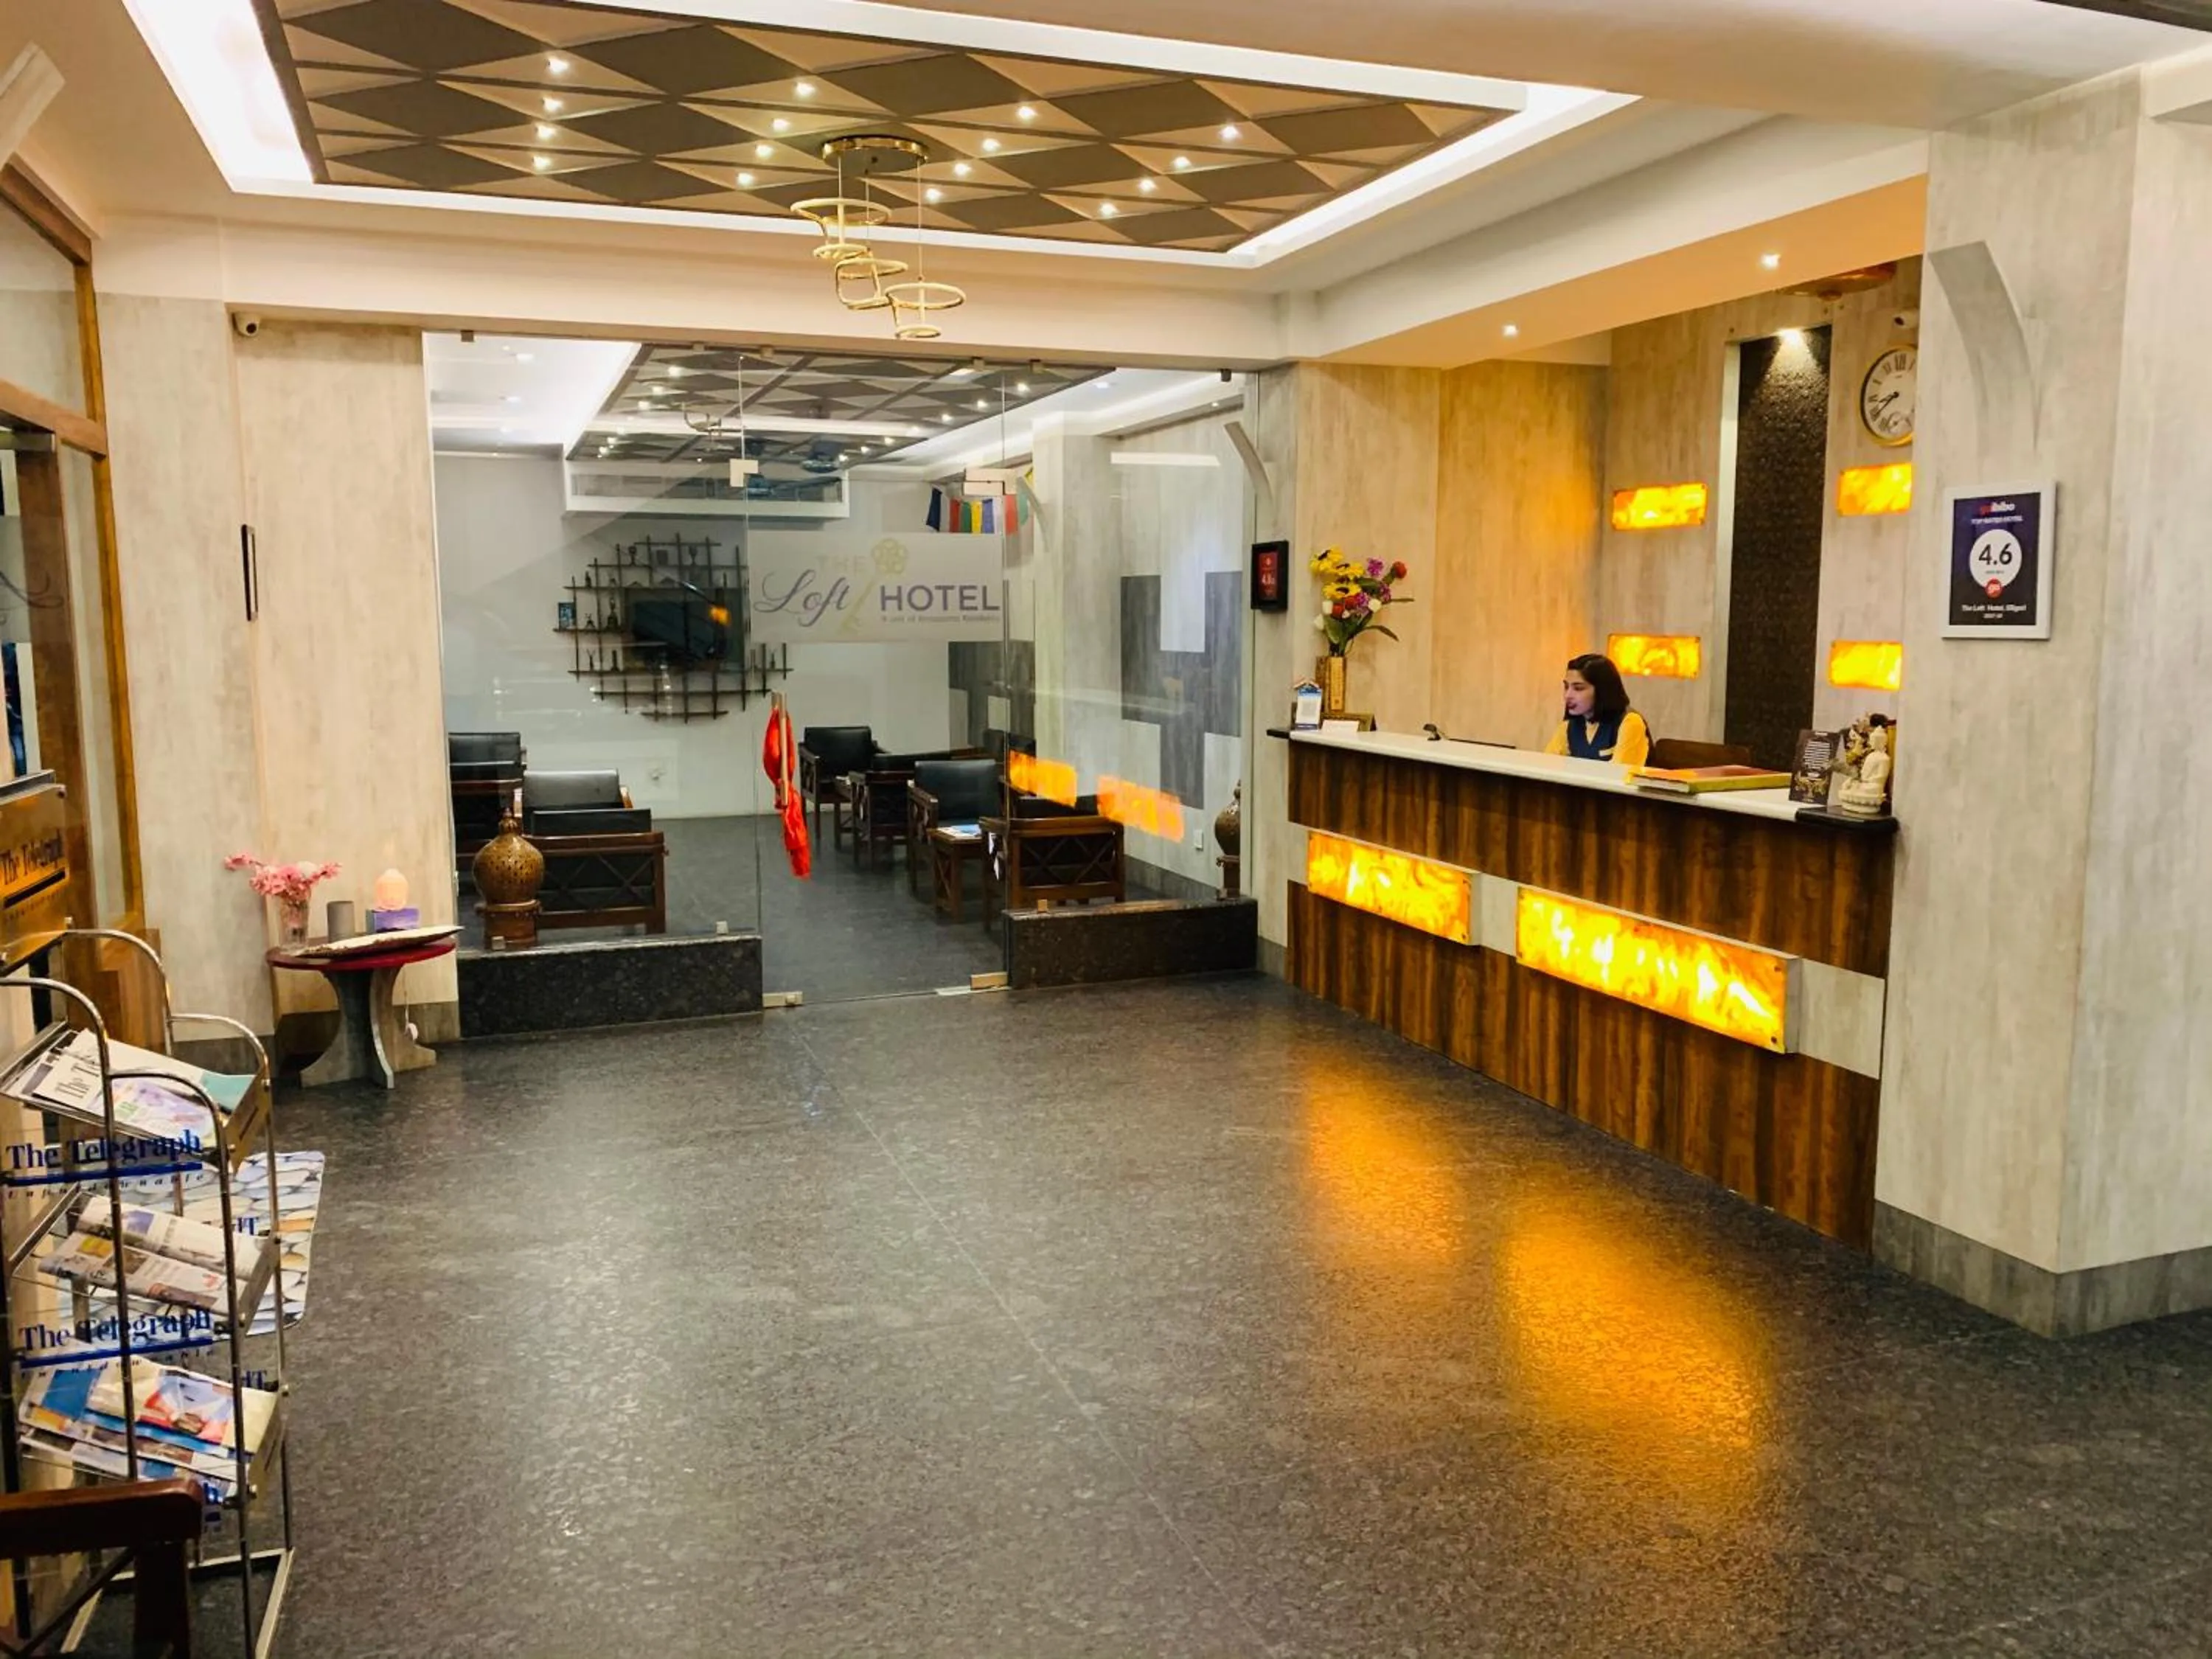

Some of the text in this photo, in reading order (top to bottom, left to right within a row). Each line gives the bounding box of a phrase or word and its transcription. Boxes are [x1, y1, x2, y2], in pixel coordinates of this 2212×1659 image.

[815, 554, 868, 575] THE
[1978, 542, 2013, 566] 4.6
[753, 569, 1001, 627] Loft HOTEL
[6, 1143, 62, 1169] The
[18, 1308, 211, 1351] The Telgraph
